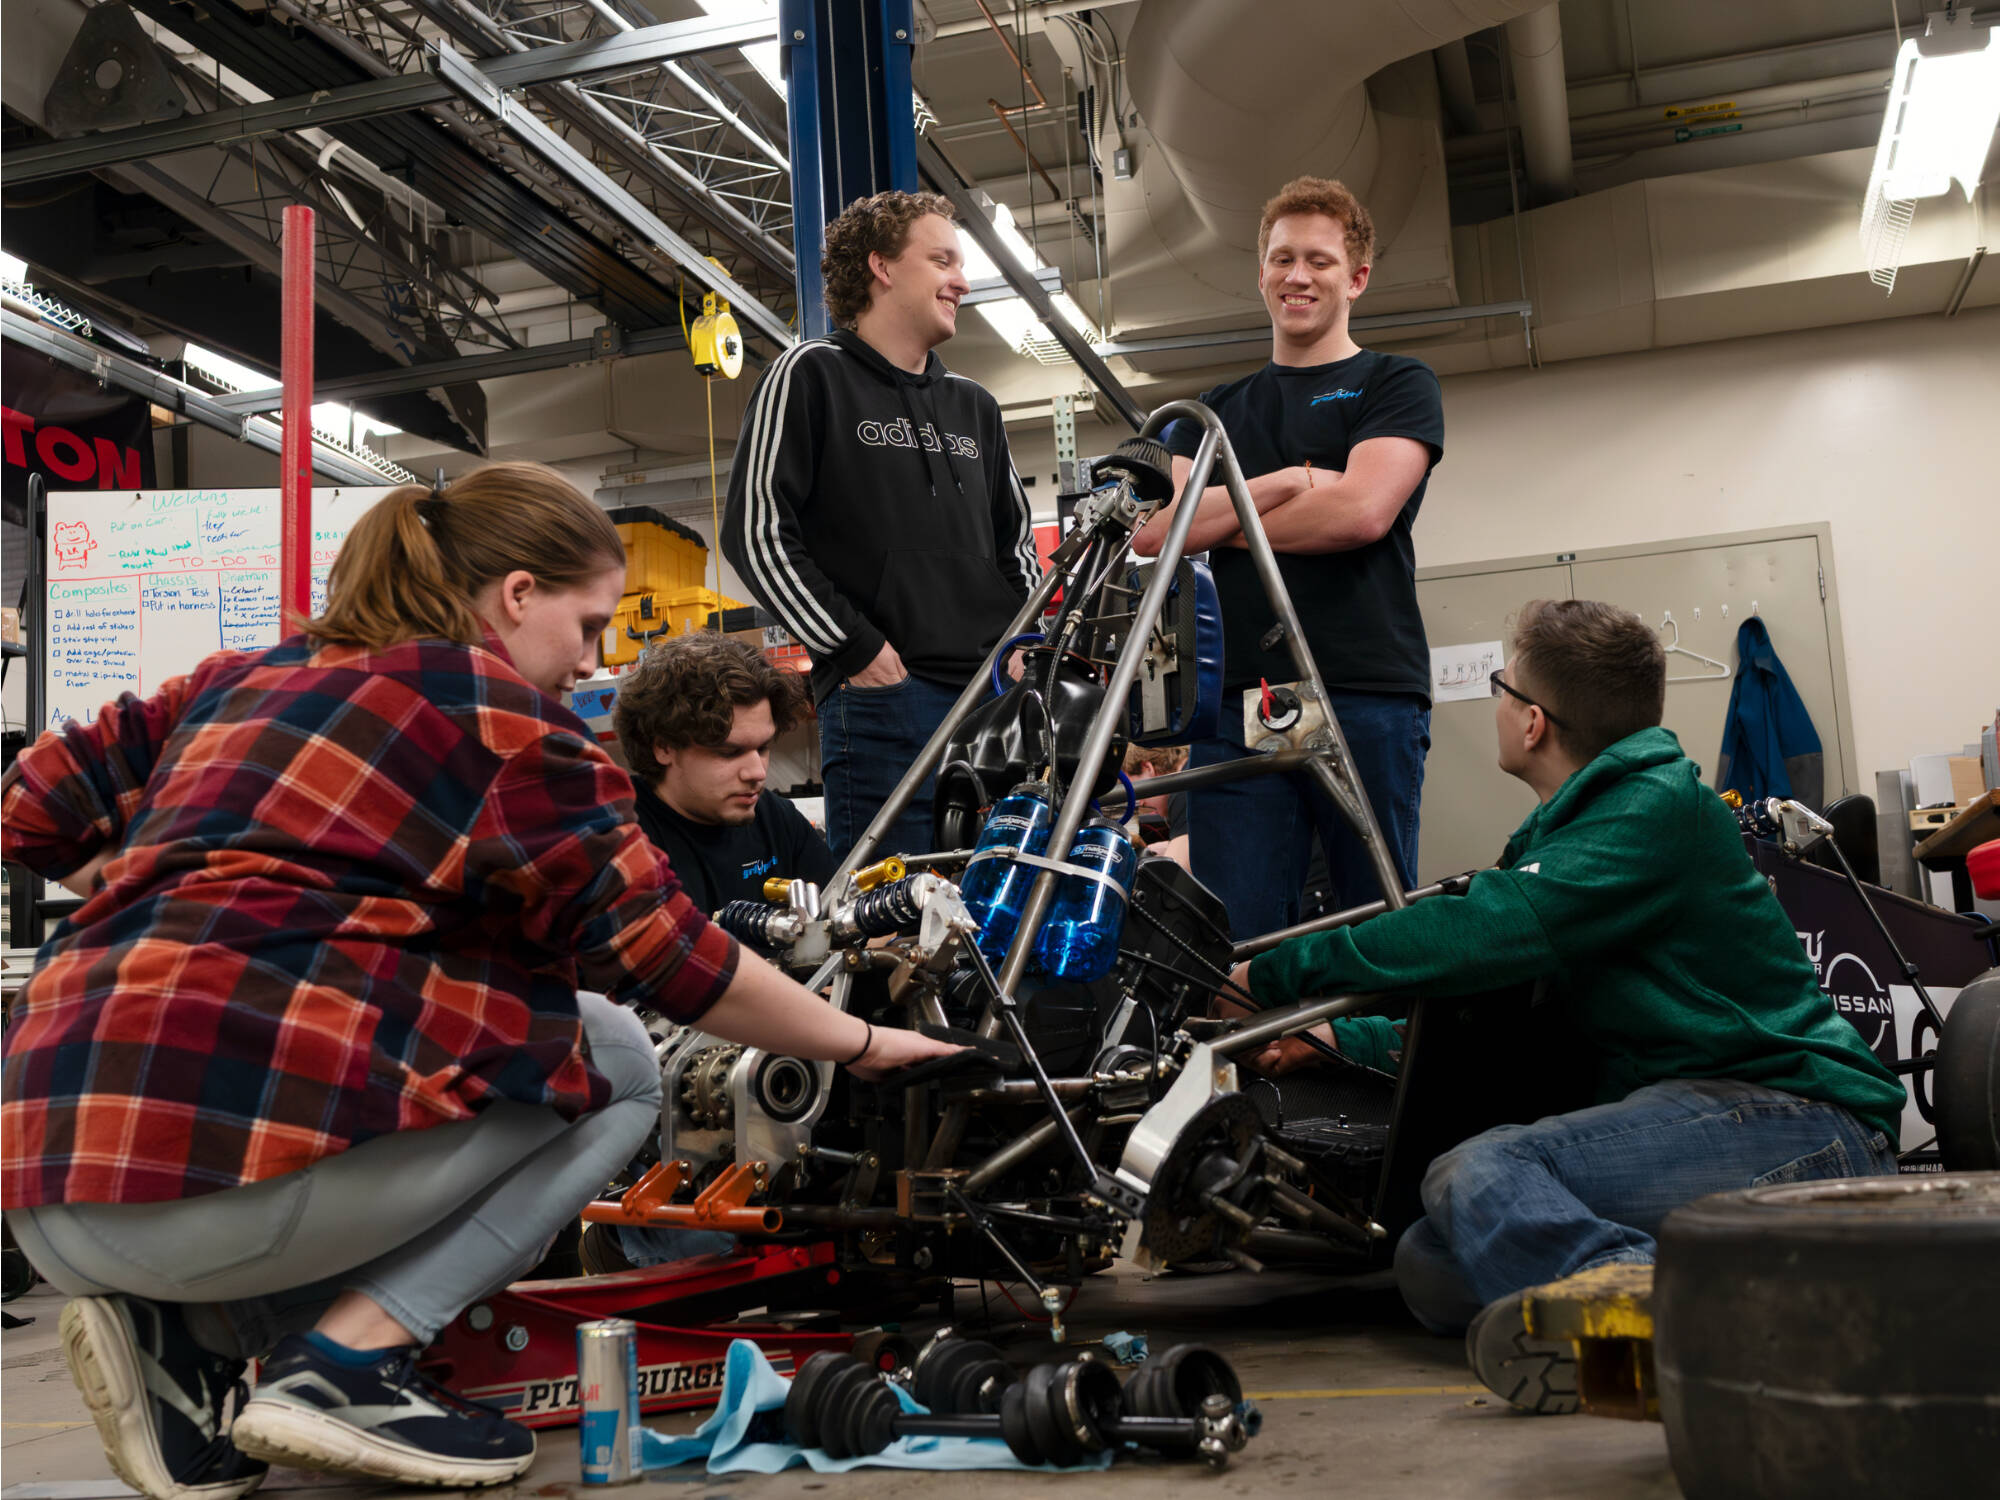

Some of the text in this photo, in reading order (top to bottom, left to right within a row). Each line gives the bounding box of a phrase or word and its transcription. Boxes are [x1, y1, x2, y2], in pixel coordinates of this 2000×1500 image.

[857, 417, 979, 459] adidas
[187, 587, 210, 598] Test
[150, 600, 217, 611] Put in harness
[66, 623, 81, 631] Add
[1827, 993, 1893, 1015] ISSAN
